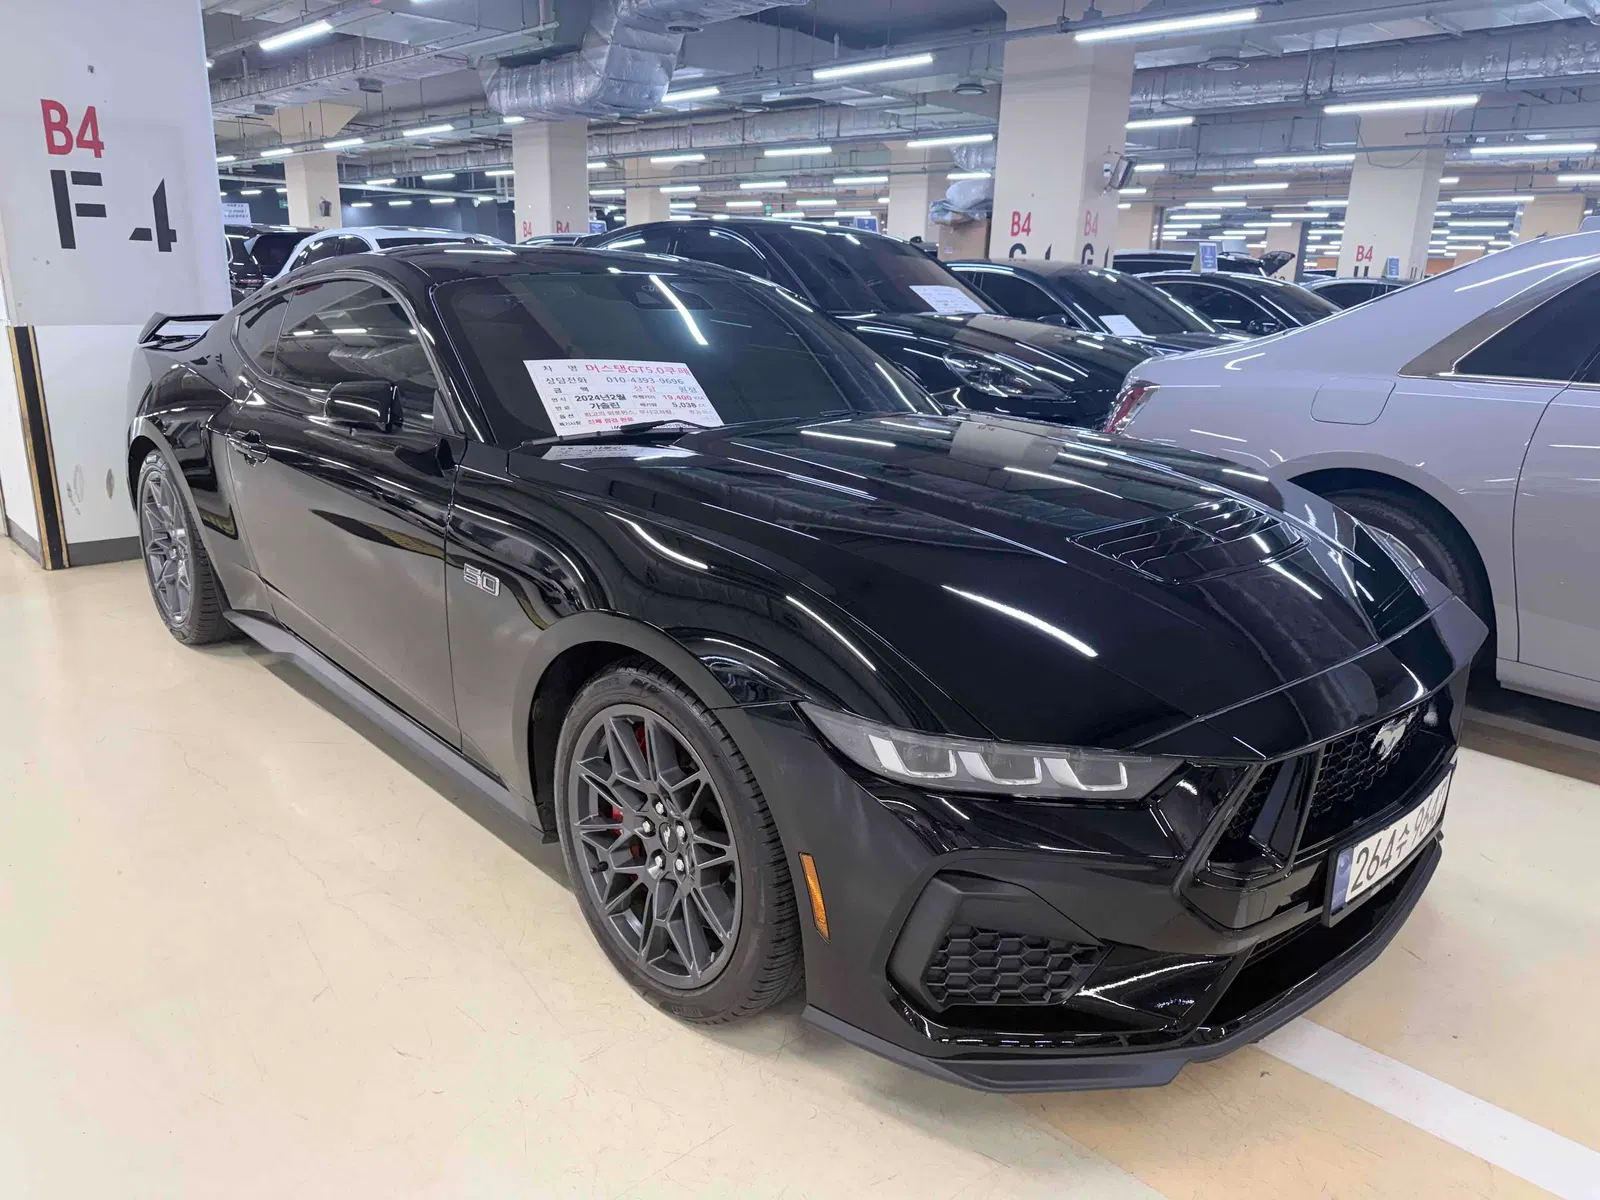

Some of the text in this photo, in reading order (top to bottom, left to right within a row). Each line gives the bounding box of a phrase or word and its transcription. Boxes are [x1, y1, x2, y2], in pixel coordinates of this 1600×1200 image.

[40, 98, 105, 158] B4
[522, 221, 532, 237] B4
[556, 221, 570, 233] B4
[1010, 211, 1032, 237] B4
[1083, 209, 1099, 236] B4
[1355, 245, 1373, 261] B4
[606, 376, 684, 385] 010-4393-9696
[574, 393, 626, 402] 2024년2월
[662, 394, 693, 402] 19,400
[671, 401, 697, 409] 5,038
[463, 562, 500, 597] 5.0
[1350, 823, 1411, 892] 264수
